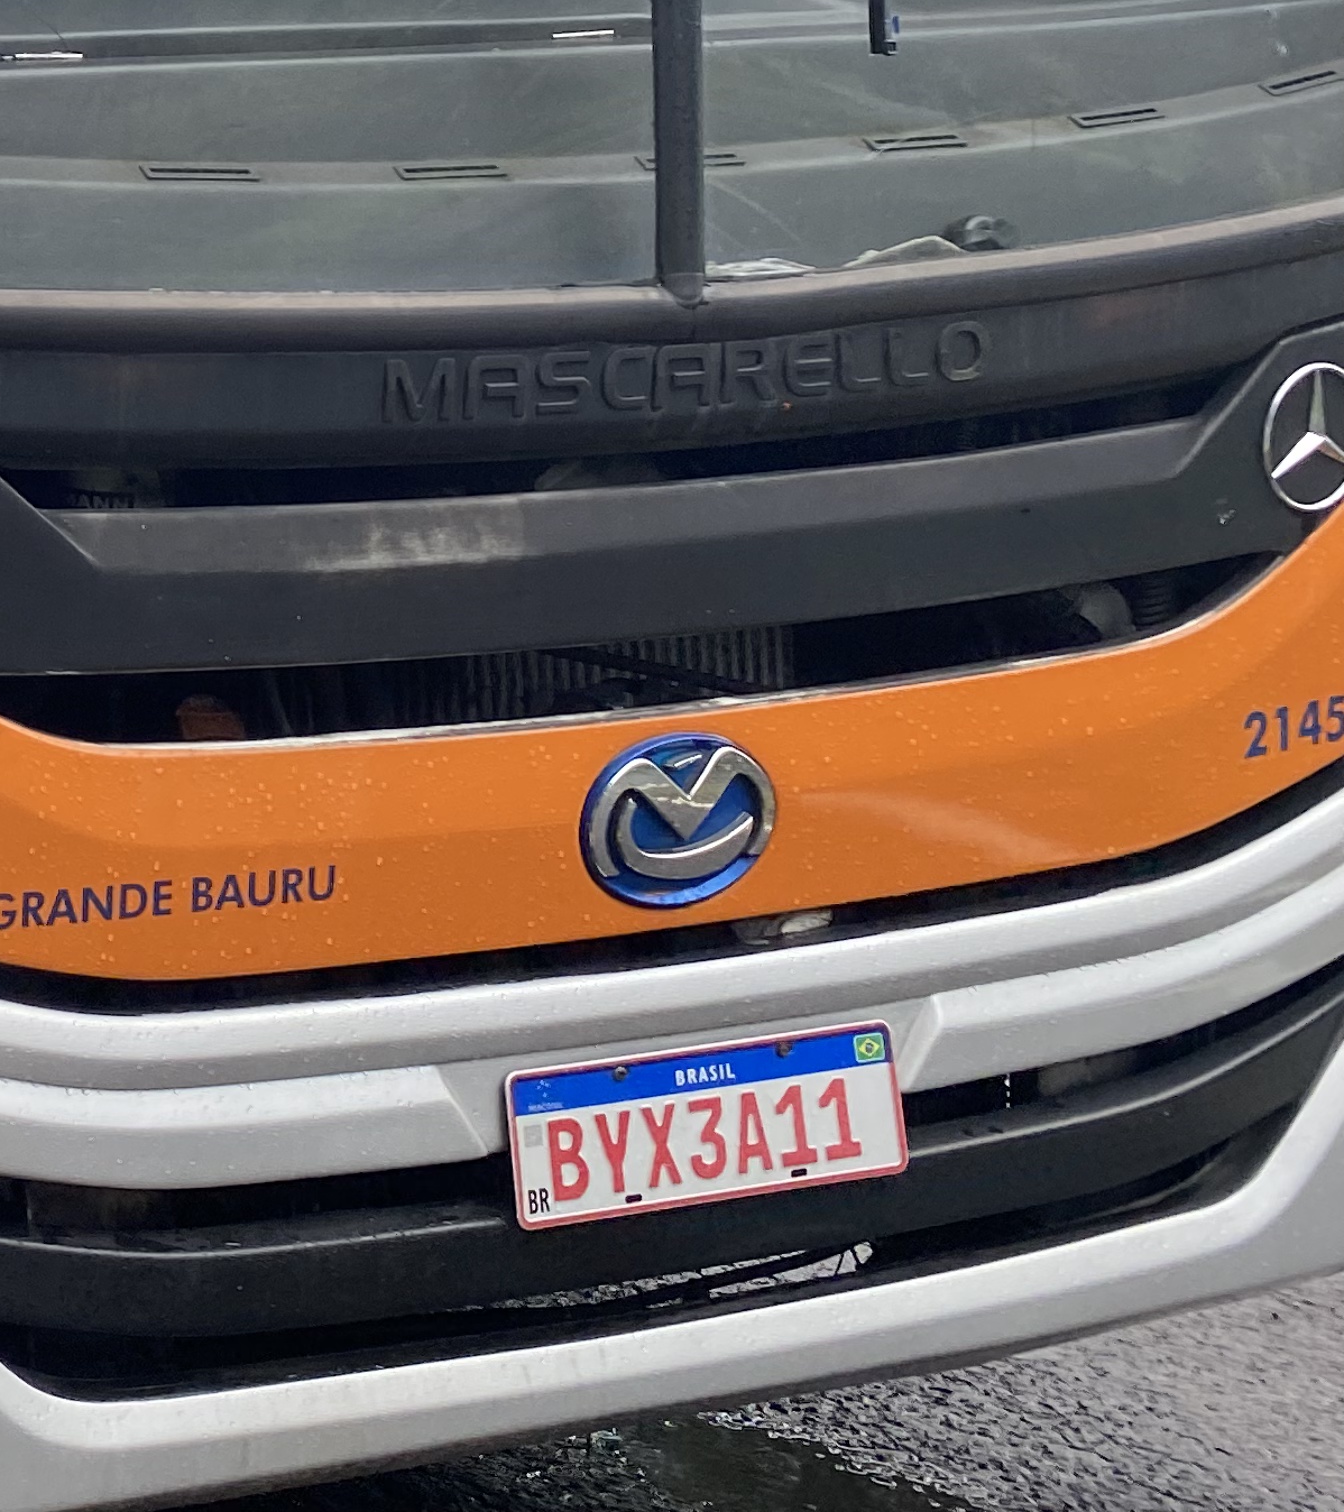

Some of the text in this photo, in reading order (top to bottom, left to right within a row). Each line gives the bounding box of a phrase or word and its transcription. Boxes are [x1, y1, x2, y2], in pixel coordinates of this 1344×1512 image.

[381, 320, 993, 424] MASCARELLO
[191, 864, 337, 913] BAURU
[674, 1062, 736, 1087] BRASIL
[547, 1077, 863, 1202] BYX3A11
[527, 1187, 551, 1215] BR
